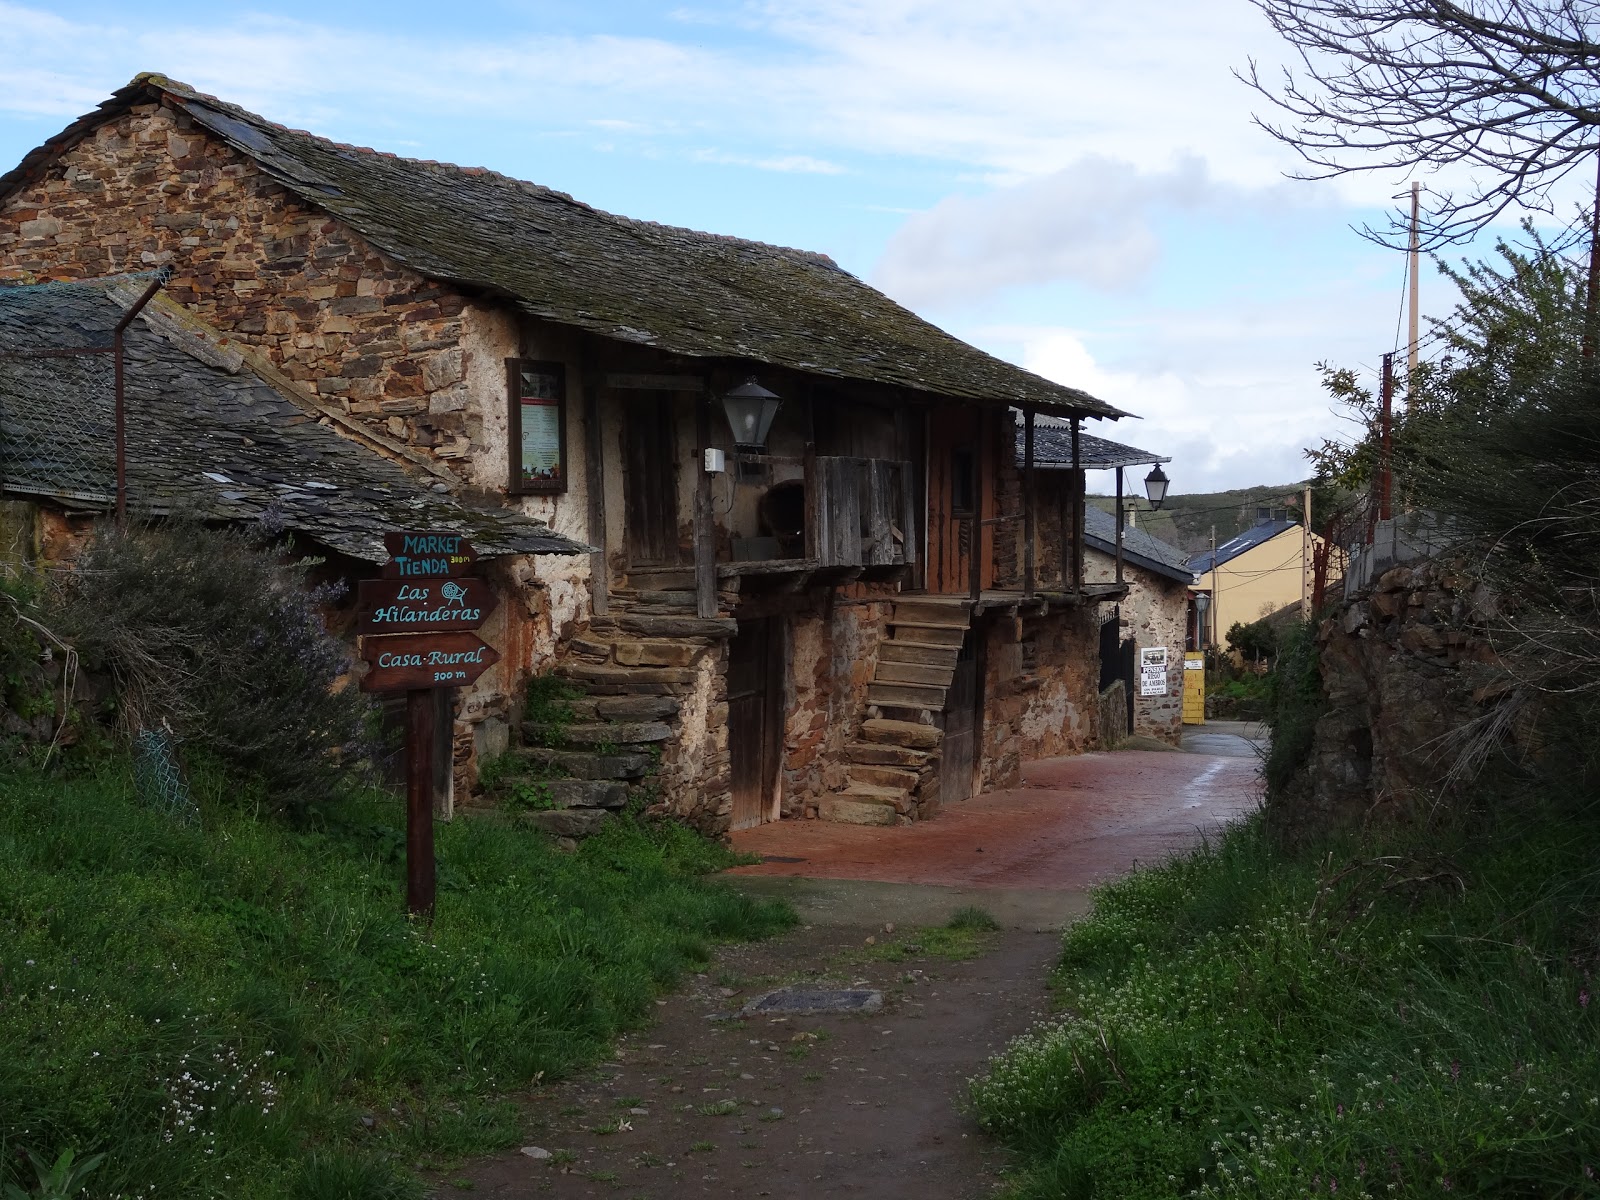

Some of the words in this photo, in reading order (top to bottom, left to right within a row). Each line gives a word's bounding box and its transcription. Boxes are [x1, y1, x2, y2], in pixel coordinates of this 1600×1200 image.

[403, 535, 462, 554] MARKET
[397, 584, 430, 601] Las
[372, 605, 480, 623] Hilanderas
[378, 652, 423, 668] Casa
[428, 646, 486, 665] Rural
[434, 671, 453, 682] 300
